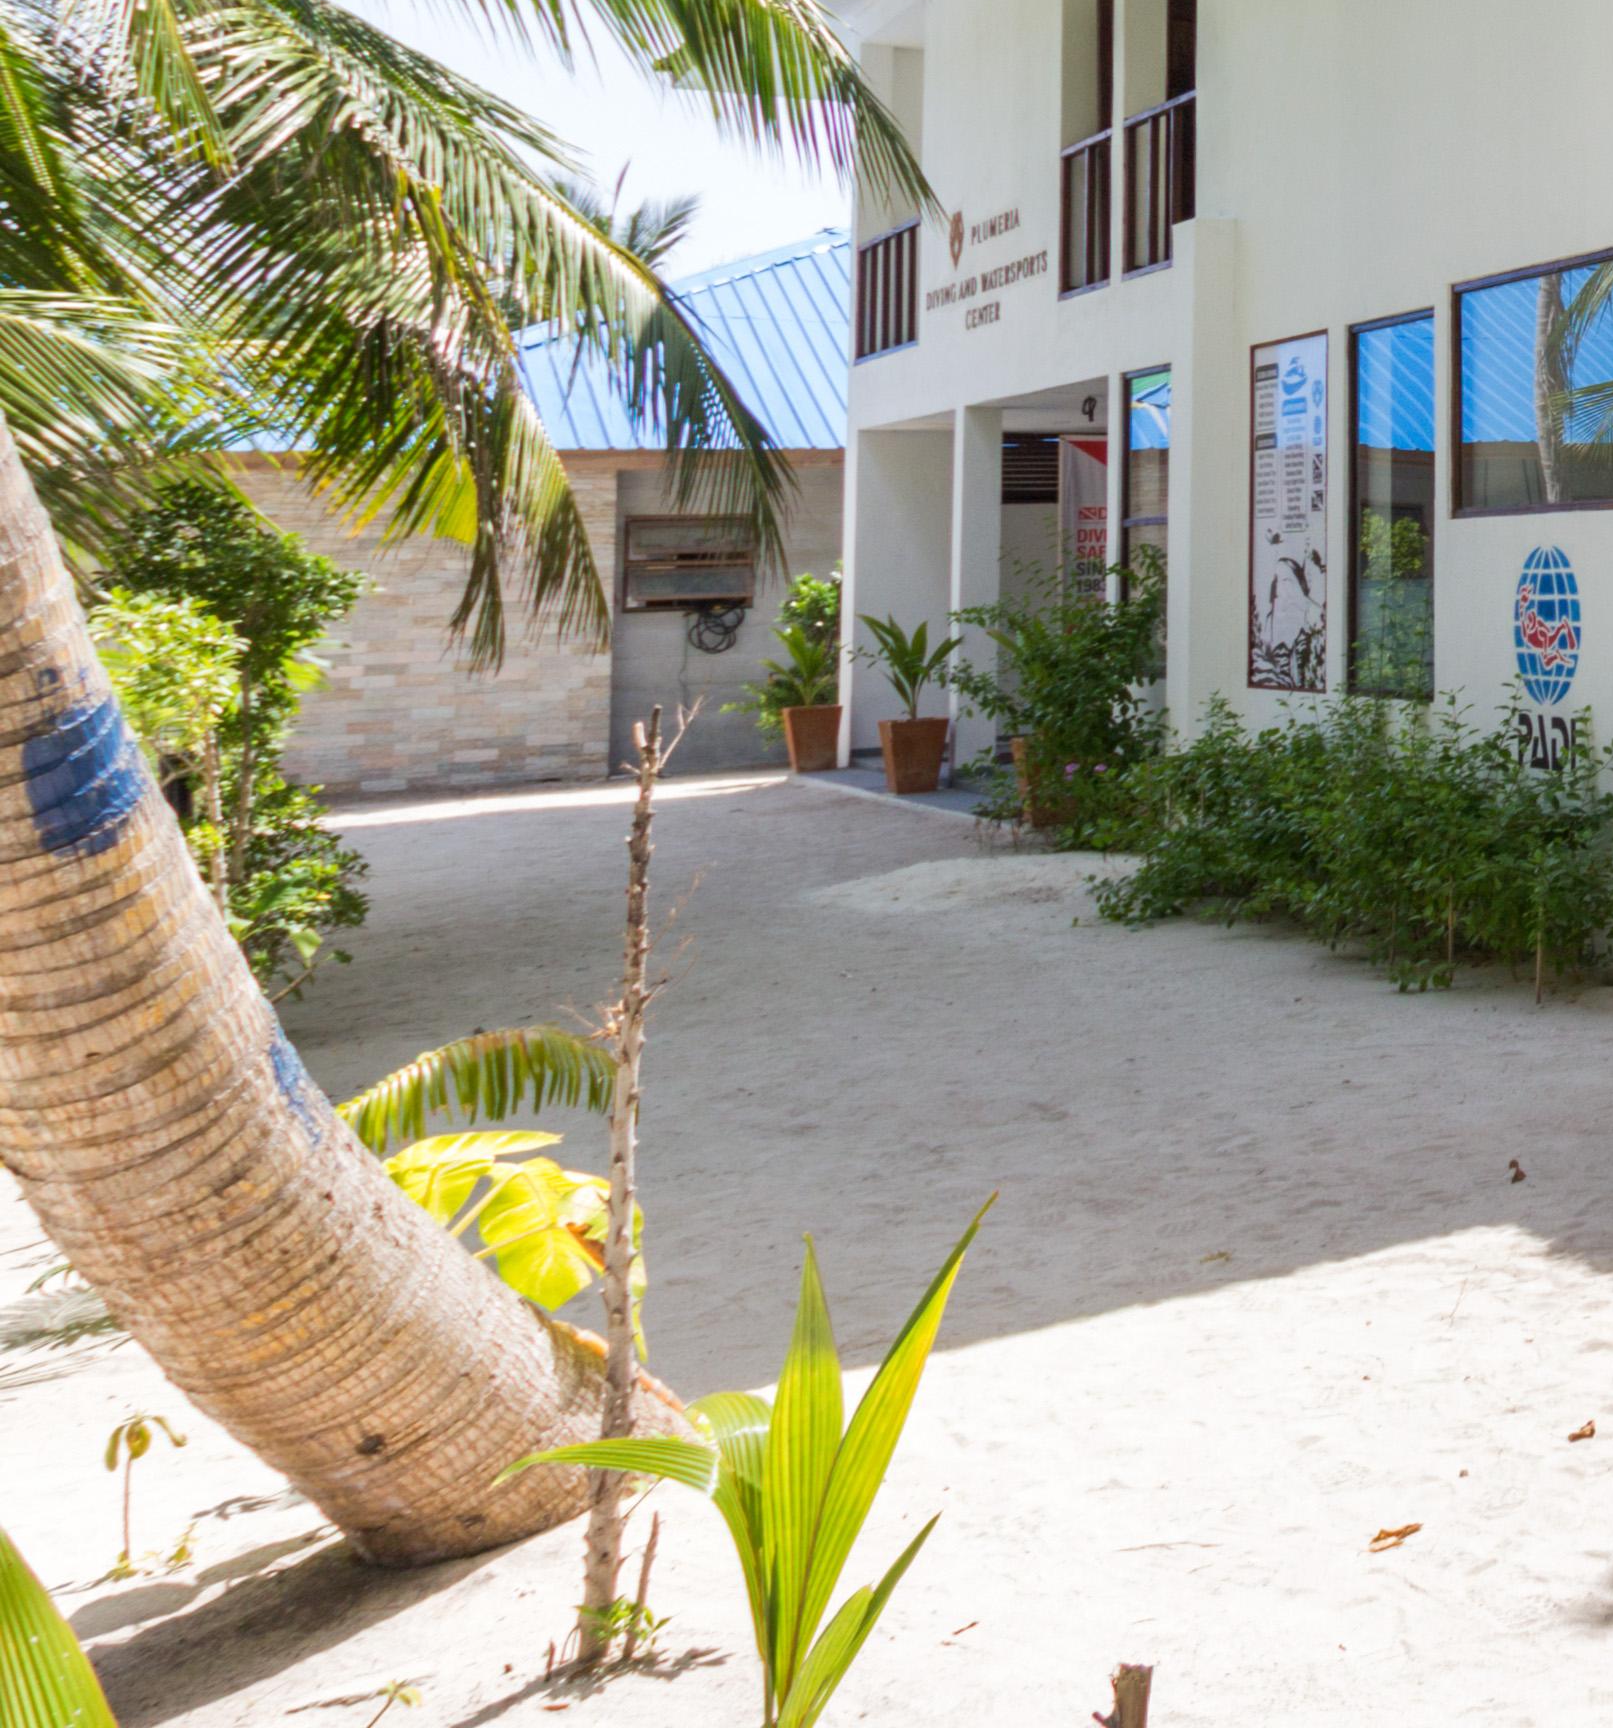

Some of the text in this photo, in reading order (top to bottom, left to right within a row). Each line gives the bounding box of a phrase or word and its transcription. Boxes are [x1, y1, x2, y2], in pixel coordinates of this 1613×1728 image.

[970, 208, 1020, 245] PLUMERIA
[926, 250, 1048, 311] DIVING AND WATERSPORTS
[965, 301, 1000, 330] CENTER
[1075, 560, 1107, 576] SIN
[1517, 713, 1577, 771] PADI
